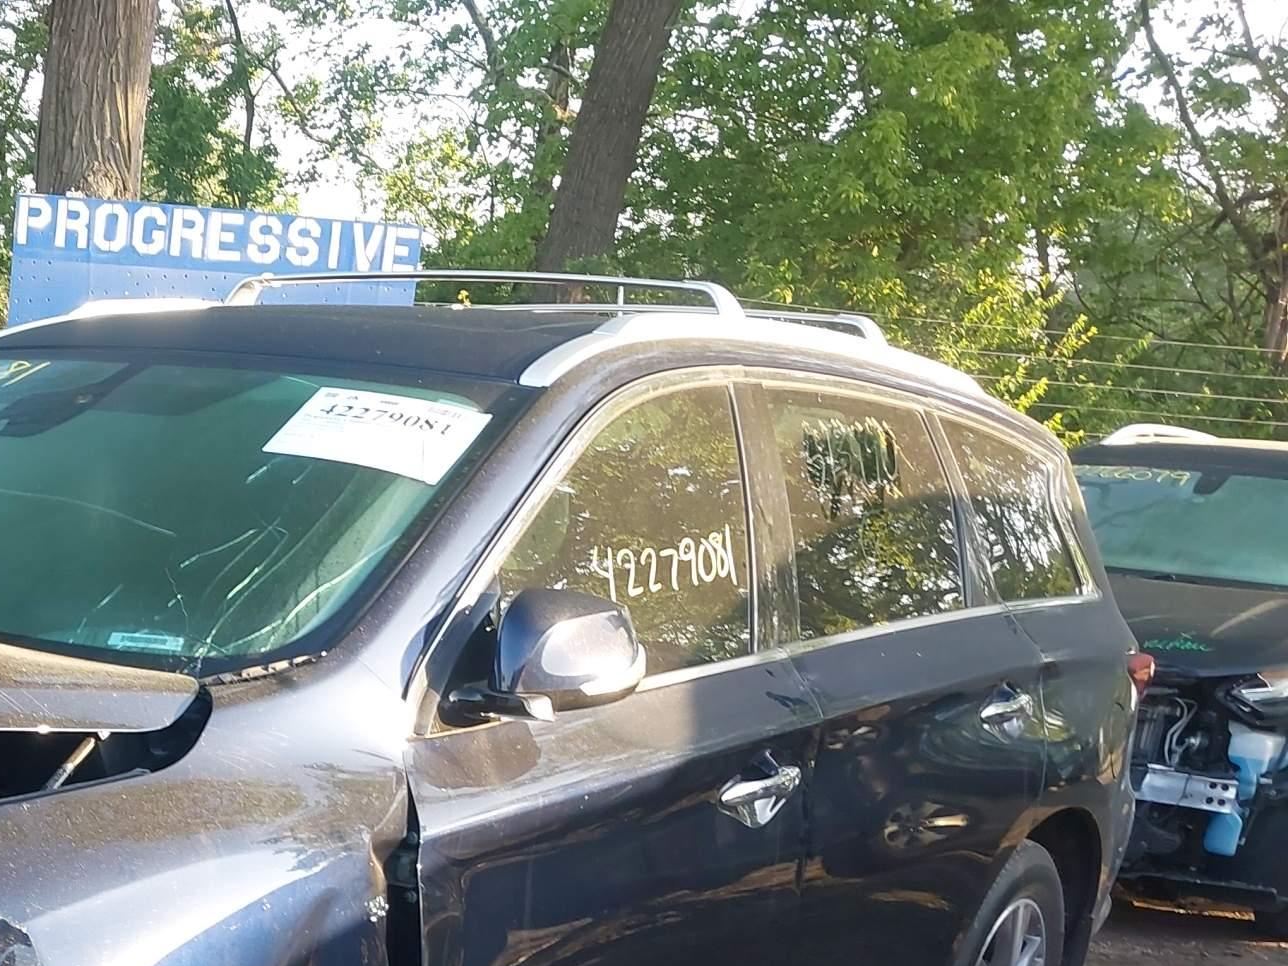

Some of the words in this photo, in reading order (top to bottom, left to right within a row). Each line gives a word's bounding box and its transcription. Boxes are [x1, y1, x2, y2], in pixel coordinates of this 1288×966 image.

[16, 197, 421, 273] PROGRESSIVE
[319, 403, 452, 436] 42279081
[590, 523, 738, 603] 42279081
